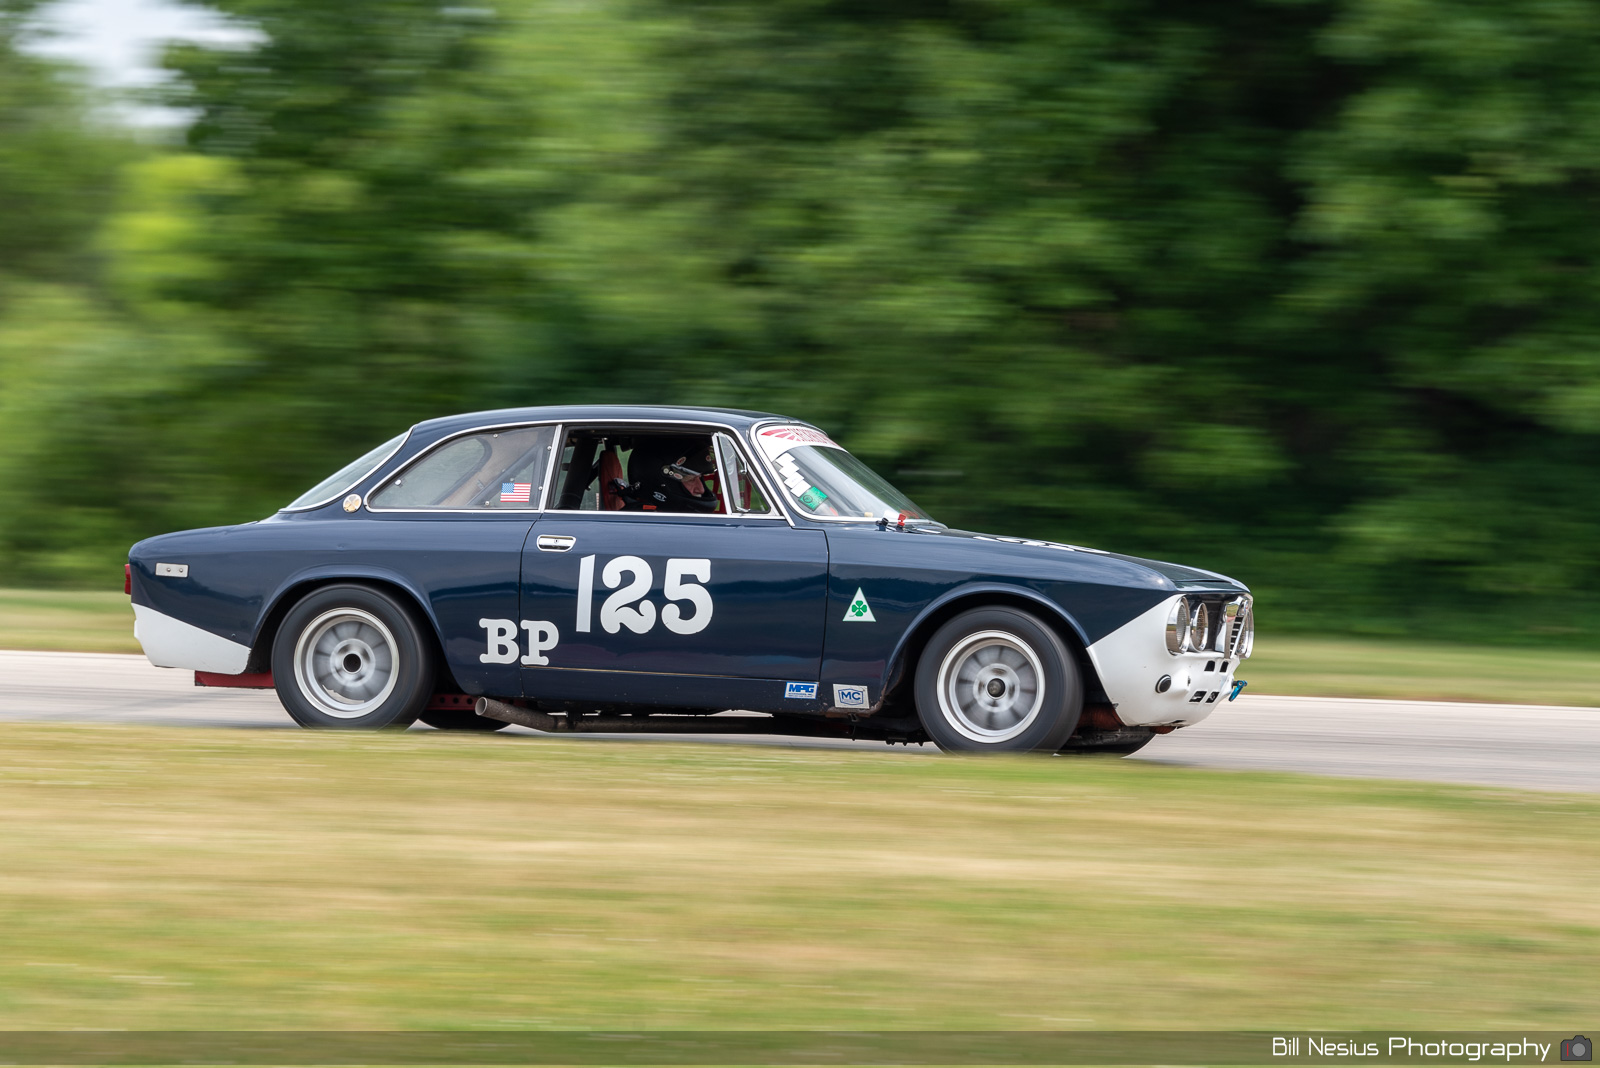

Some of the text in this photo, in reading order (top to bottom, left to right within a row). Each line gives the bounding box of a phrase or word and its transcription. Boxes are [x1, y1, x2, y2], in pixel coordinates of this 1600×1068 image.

[576, 554, 714, 635] 125
[478, 618, 560, 666] BP
[788, 684, 814, 693] MPG
[841, 691, 861, 700] MC
